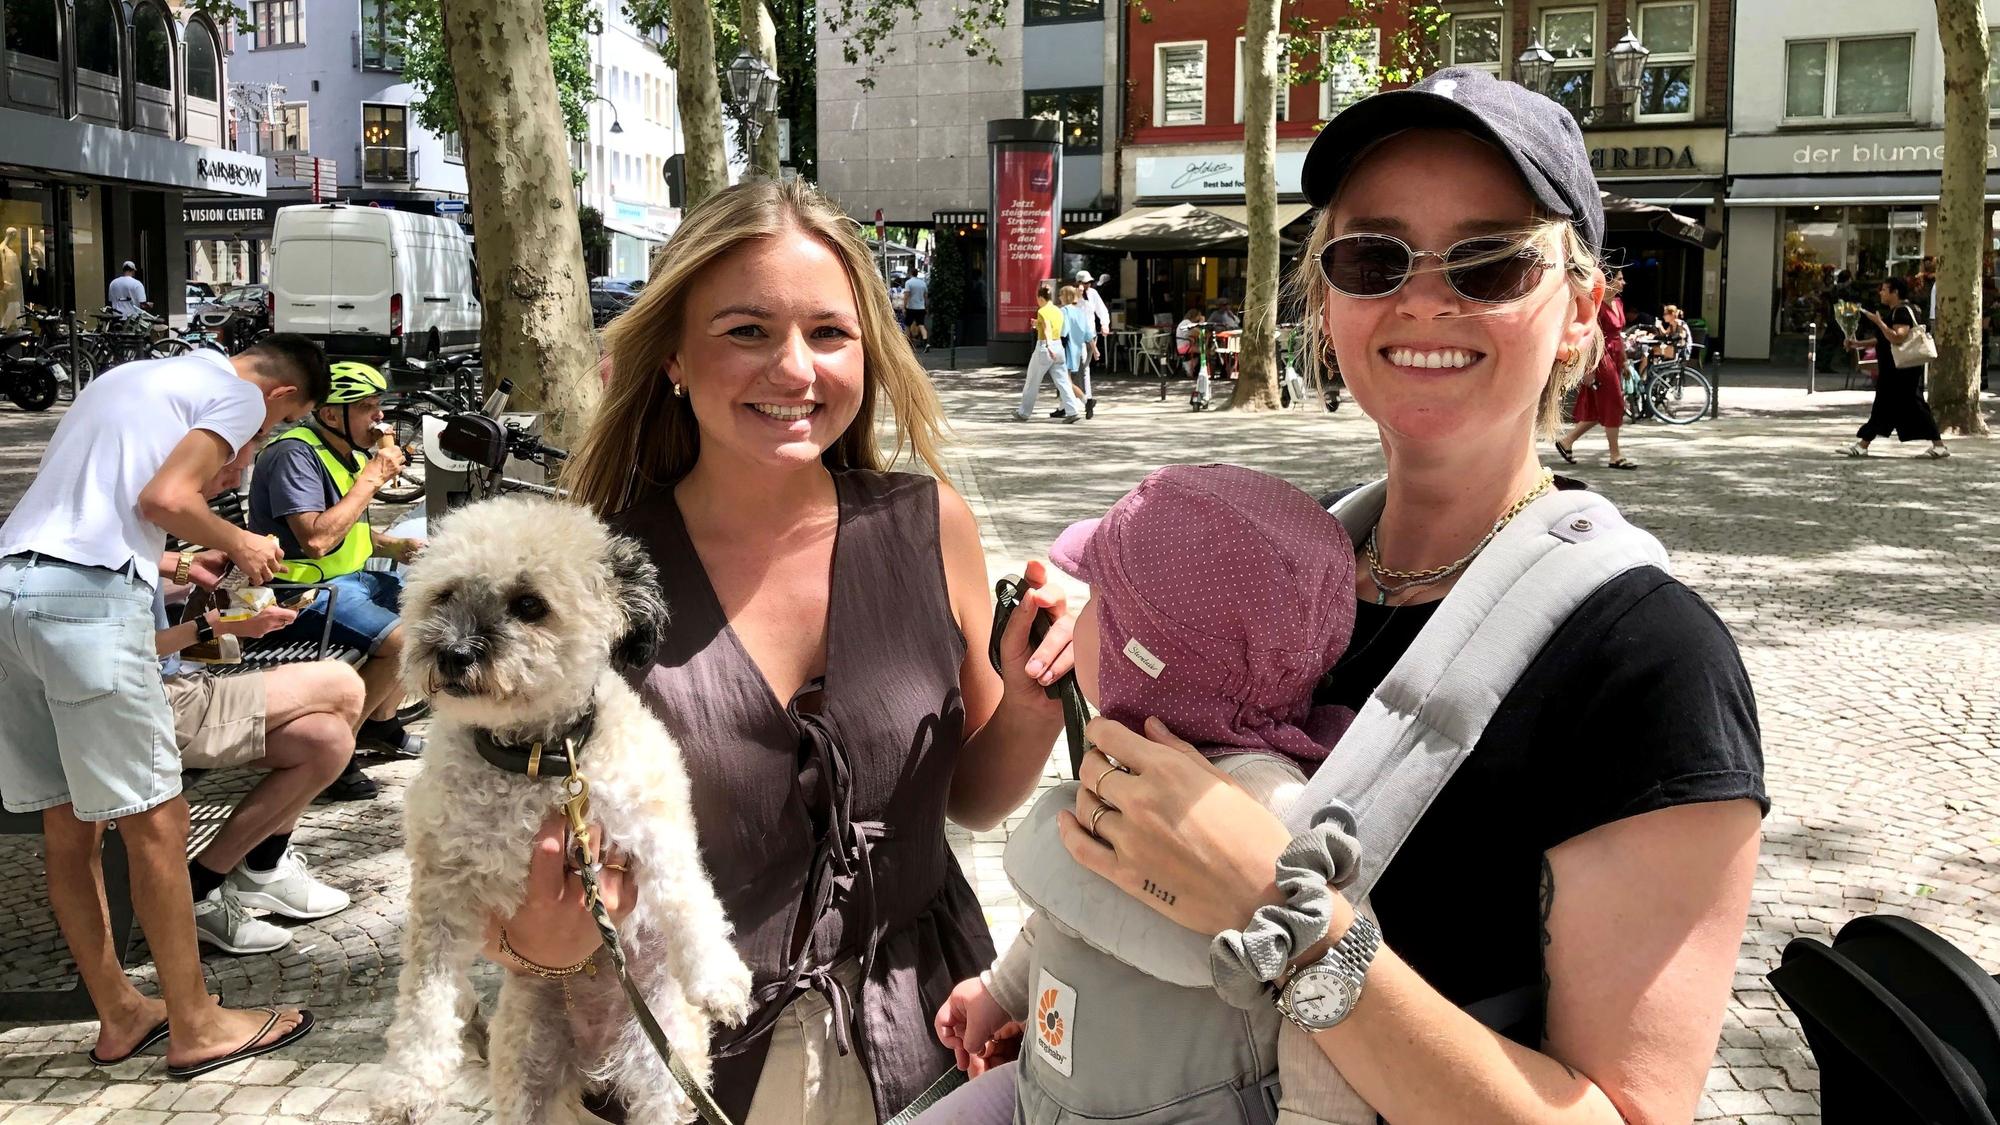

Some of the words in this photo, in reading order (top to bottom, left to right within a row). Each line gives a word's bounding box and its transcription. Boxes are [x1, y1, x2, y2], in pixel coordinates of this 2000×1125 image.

[1590, 145, 1697, 169] BREDA
[1793, 144, 1840, 164] der
[197, 157, 262, 187] RAINBOW
[1203, 180, 1219, 188] Best
[1220, 180, 1233, 188] bad
[1235, 180, 1246, 188] foo
[1011, 200, 1035, 208] Jetzt
[190, 208, 223, 222] VISION
[226, 207, 264, 221] CENTER
[1001, 208, 1051, 218] steigenden
[1006, 217, 1038, 226] Strom-
[1010, 226, 1047, 235] preisen
[1017, 235, 1036, 243] den
[1008, 243, 1043, 252] Stecker
[1142, 879, 1176, 906] 11:11
